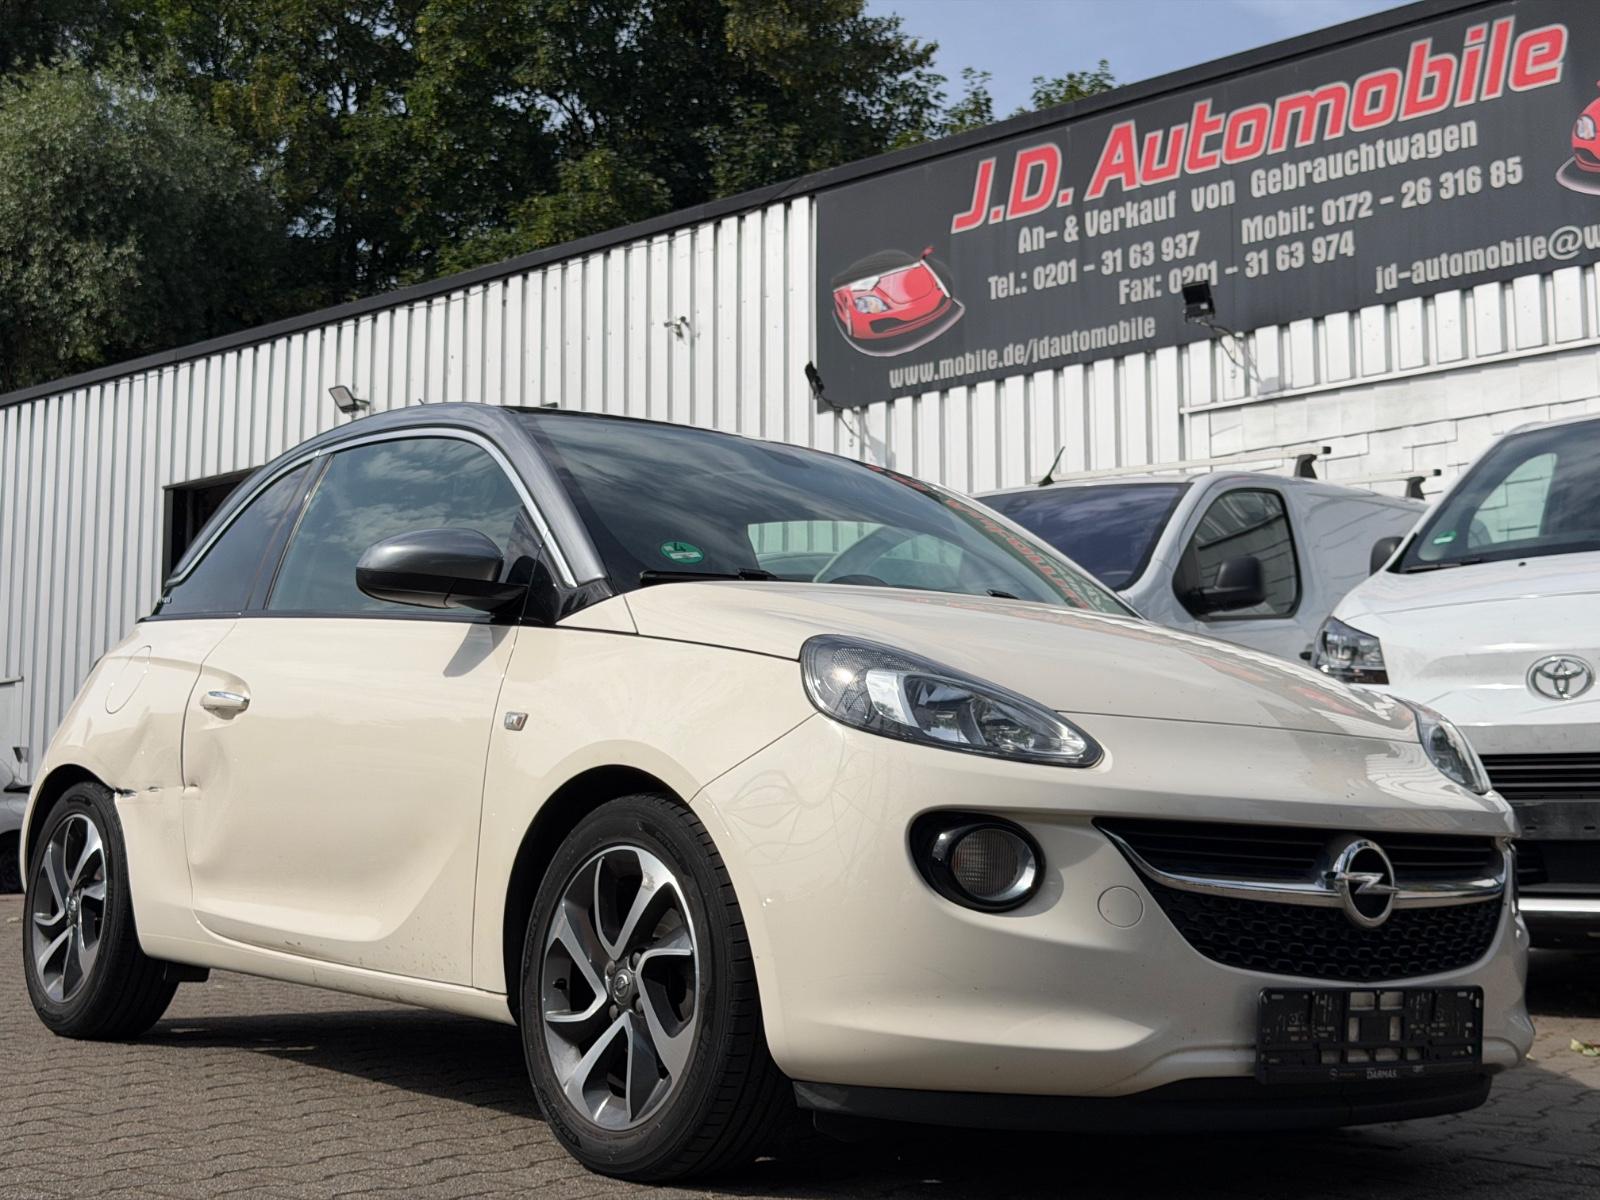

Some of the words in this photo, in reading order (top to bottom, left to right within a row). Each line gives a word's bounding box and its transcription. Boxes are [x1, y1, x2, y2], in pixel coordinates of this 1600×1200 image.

[951, 142, 1074, 235] J.D.
[1084, 15, 1568, 202] Automobile
[1018, 225, 1058, 254] An-
[1064, 215, 1079, 243] &
[1085, 190, 1176, 238] Verkauf
[1191, 179, 1236, 212] von
[1250, 120, 1479, 198] Gebrauchtwagen
[1241, 205, 1315, 245] Mobil:
[1321, 191, 1373, 226] 0172
[1401, 177, 1432, 208] 26
[1439, 165, 1482, 200] 316
[1490, 156, 1523, 188] 85
[988, 271, 1027, 300] Tel.:
[1033, 258, 1078, 290] 0201
[1100, 248, 1123, 275] 31
[1129, 241, 1155, 269] 63
[1161, 230, 1200, 262] 937
[1119, 274, 1162, 305] Fax:
[1245, 250, 1268, 279] 31
[1276, 241, 1304, 271] 63
[1312, 230, 1355, 264] 974
[889, 316, 1156, 389] www.mobile.de/jdautomobile
